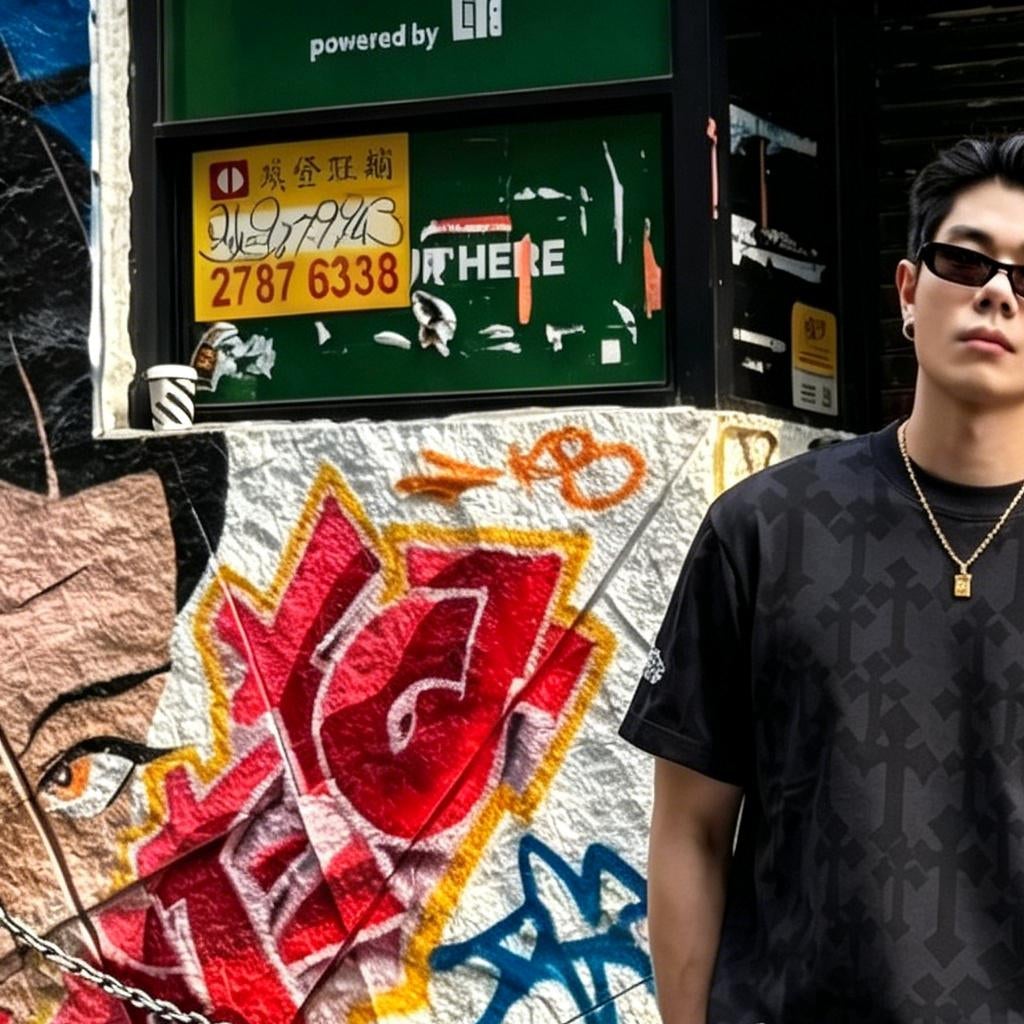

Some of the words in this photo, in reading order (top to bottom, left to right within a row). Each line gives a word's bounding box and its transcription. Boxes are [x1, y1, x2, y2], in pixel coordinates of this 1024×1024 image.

[309, 24, 406, 62] powered
[411, 22, 440, 51] by
[210, 261, 296, 308] 2787
[307, 251, 399, 300] 6338
